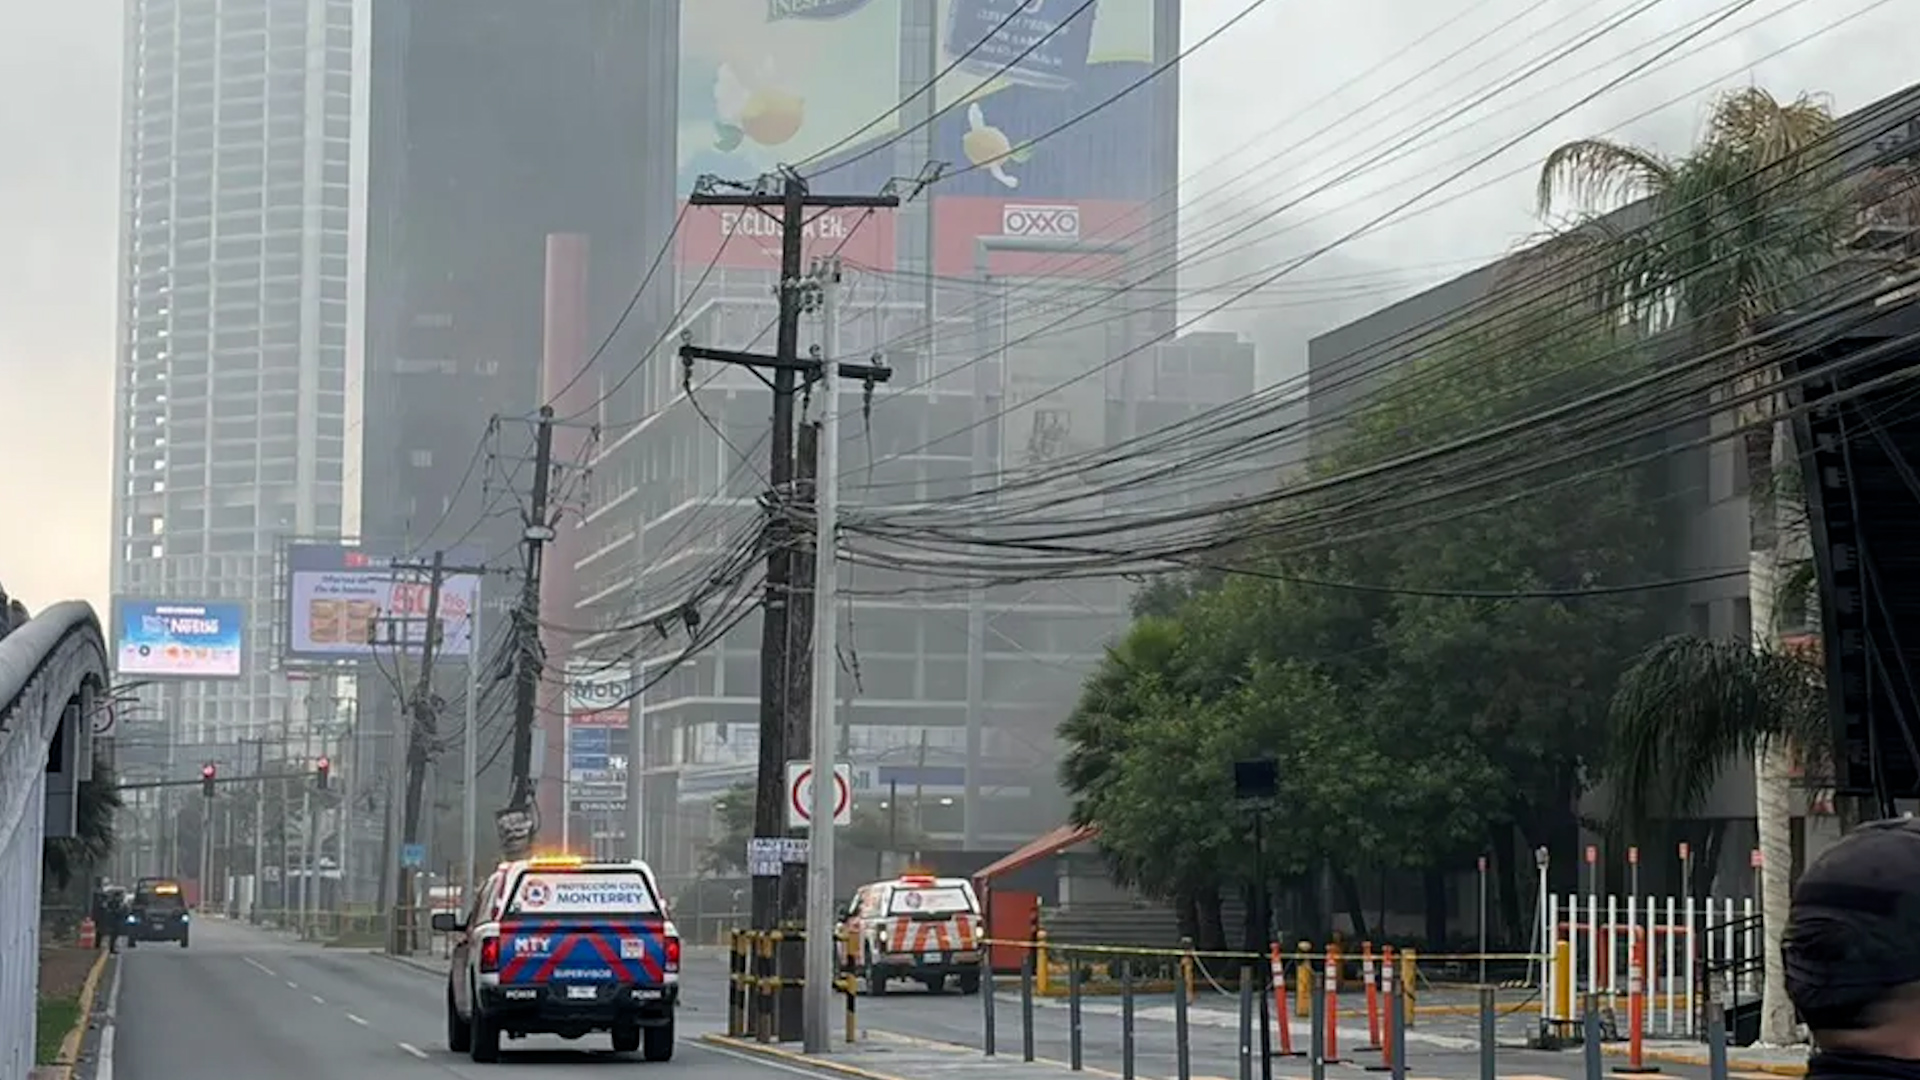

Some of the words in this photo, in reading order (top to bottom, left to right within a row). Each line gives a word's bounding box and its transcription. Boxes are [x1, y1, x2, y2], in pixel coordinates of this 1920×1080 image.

[721, 211, 815, 238] EXCLUSA
[1006, 210, 1077, 235] OXXO
[556, 881, 618, 892] PROTECCIÓN
[618, 882, 642, 892] CIVIL
[556, 892, 643, 904] MONTERREY
[514, 937, 552, 952] MTY
[553, 968, 612, 978] SUPERVISOR
